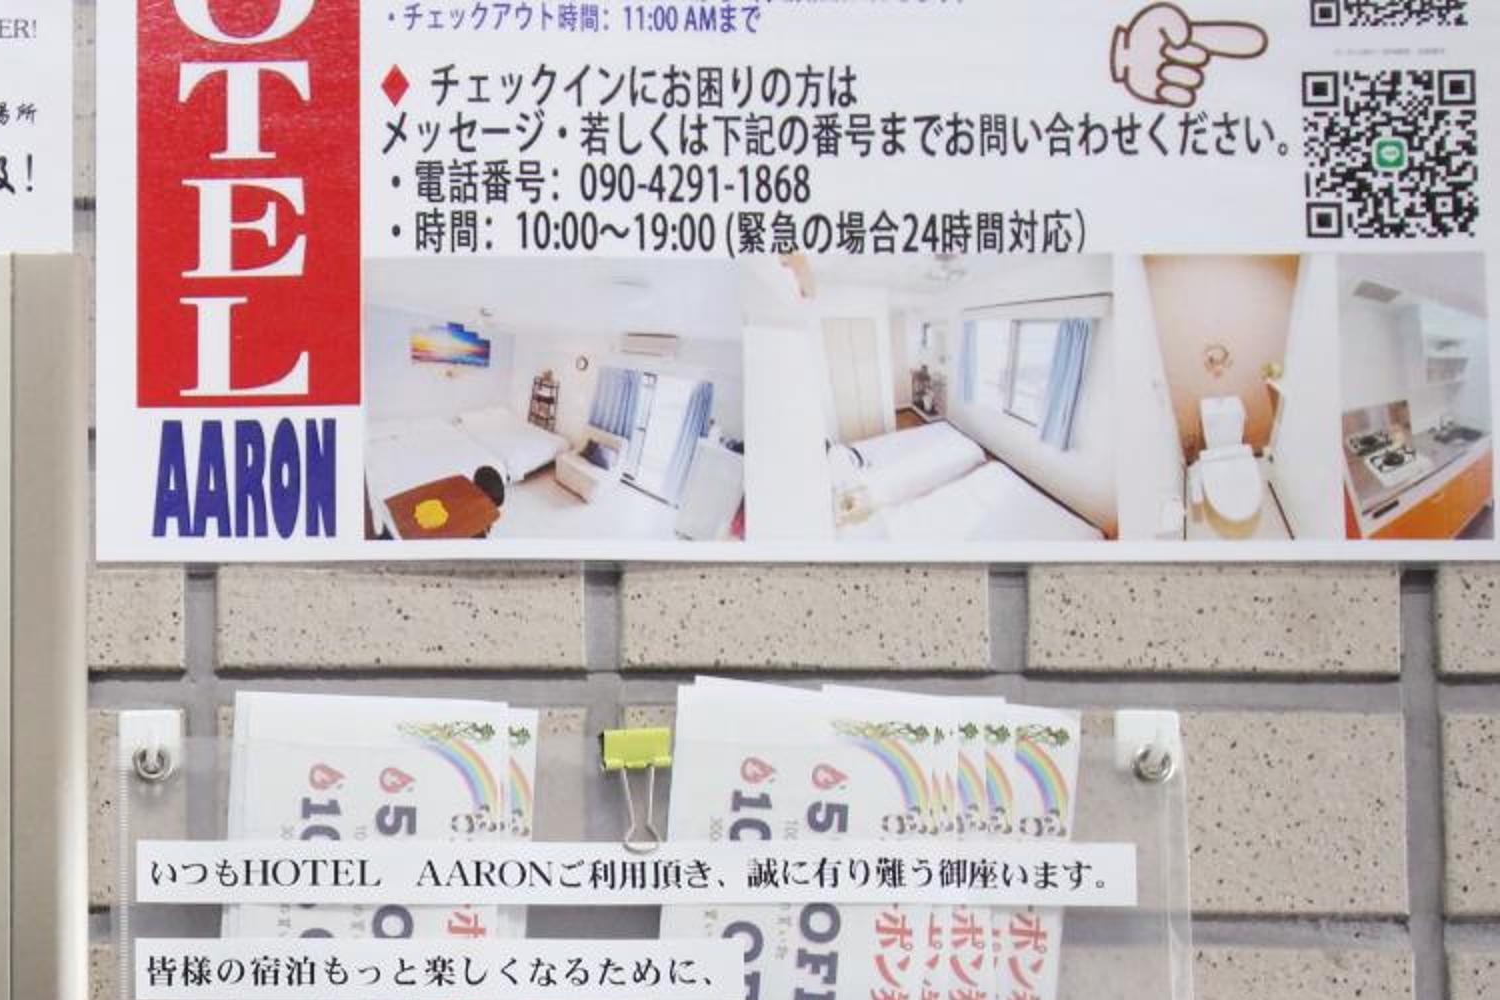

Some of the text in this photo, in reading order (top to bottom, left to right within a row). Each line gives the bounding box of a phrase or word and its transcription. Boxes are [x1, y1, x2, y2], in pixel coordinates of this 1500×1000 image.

[431, 62, 858, 108] チェックインにお困りの方は
[152, 417, 337, 539] AARON
[150, 859, 381, 889] いつもHOTEL
[146, 955, 716, 987] 皆様の宿泊もっと楽しくなるために、
